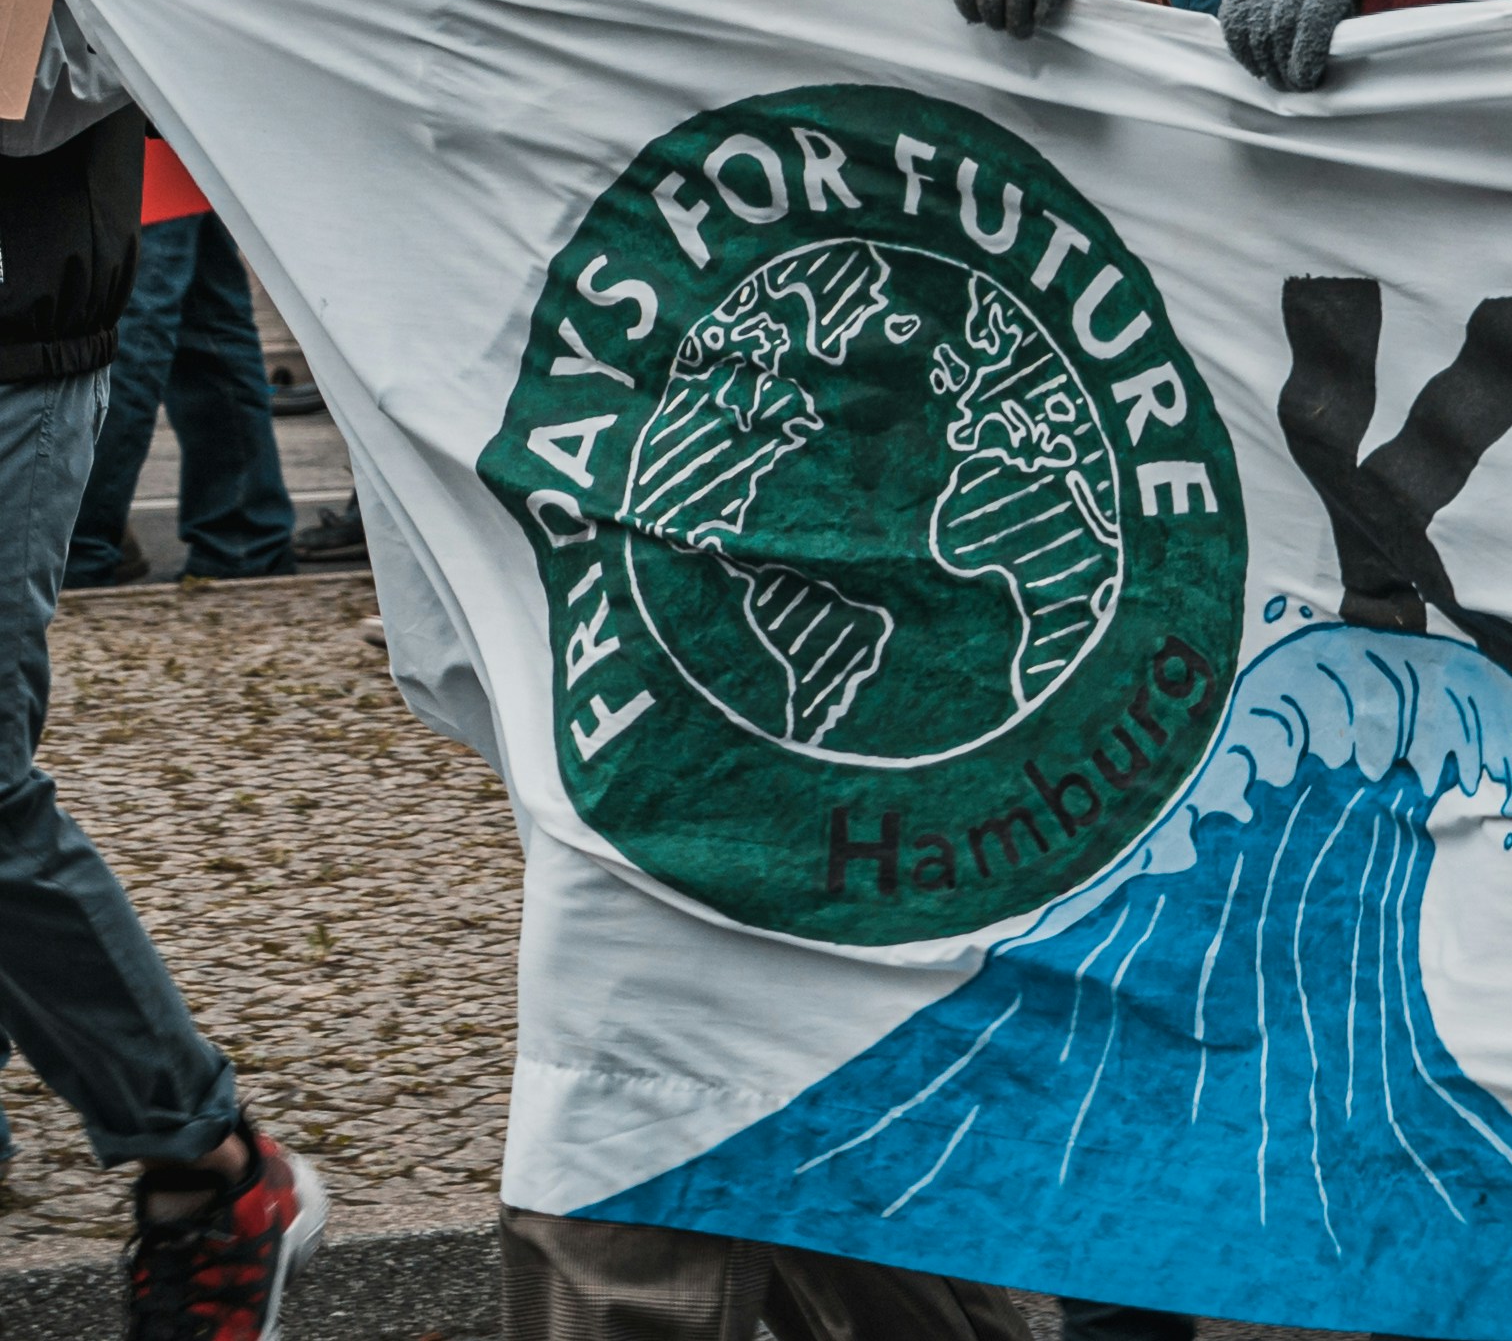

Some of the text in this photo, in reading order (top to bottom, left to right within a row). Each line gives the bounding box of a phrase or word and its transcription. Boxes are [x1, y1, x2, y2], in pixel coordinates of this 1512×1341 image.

[648, 124, 863, 272] FOR
[894, 131, 1220, 523] FUTURE
[824, 631, 1219, 900] Hamburg
